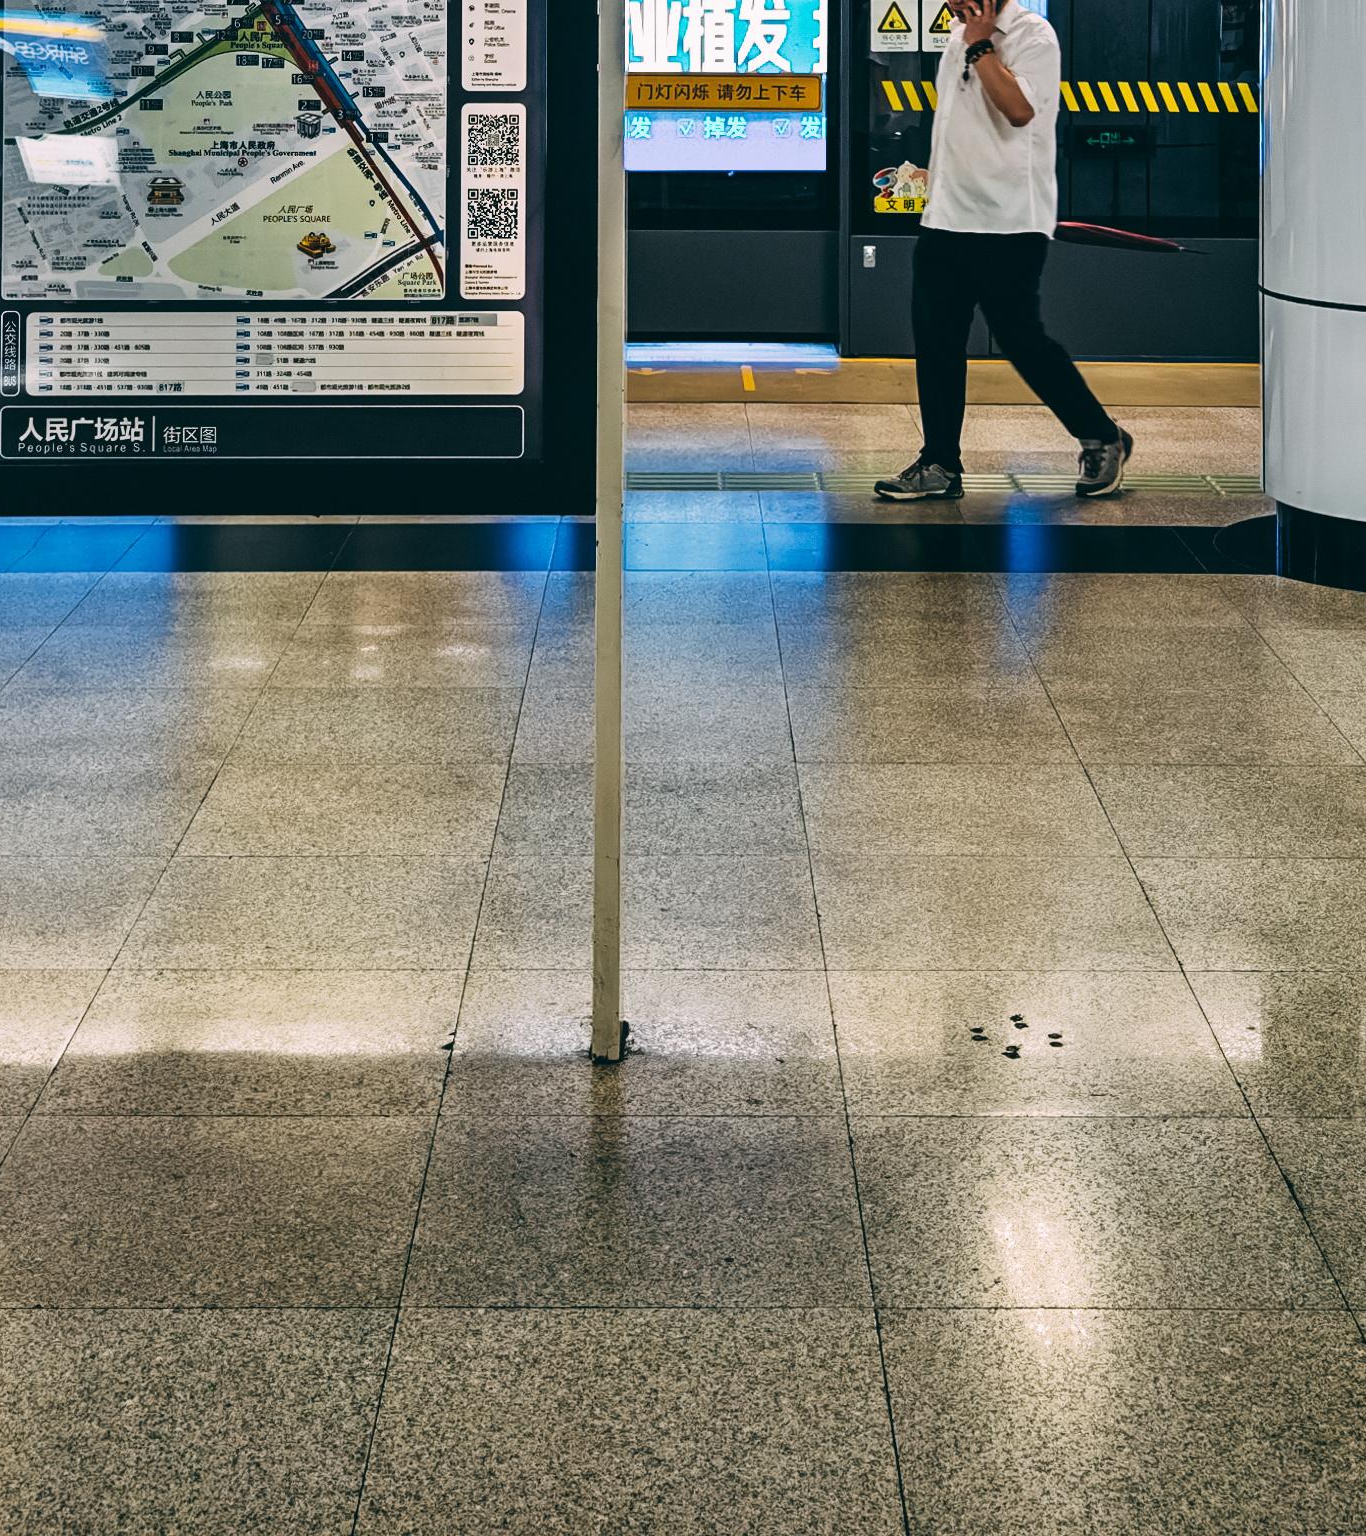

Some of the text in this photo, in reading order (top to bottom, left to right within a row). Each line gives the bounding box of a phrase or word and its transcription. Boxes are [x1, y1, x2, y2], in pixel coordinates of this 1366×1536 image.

[196, 91, 231, 99] 人民公园
[637, 83, 806, 101] 门灯闪烁 请勿上下车
[704, 117, 747, 139] 掉发
[800, 117, 826, 139] 发
[212, 141, 276, 150] 上海市人民政府
[273, 149, 317, 158] Government
[211, 202, 241, 226] 人民大道
[278, 205, 313, 214] 人民广场
[263, 215, 331, 223] PEOPLE'S SQUARE
[402, 272, 433, 280] 广场公园
[4, 321, 16, 371] 公交线路
[4, 376, 16, 386] BUS
[19, 417, 145, 442] 人民广场站
[163, 426, 217, 444] 街区图
[18, 443, 146, 454] People's Square S.
[202, 445, 218, 454] Map
